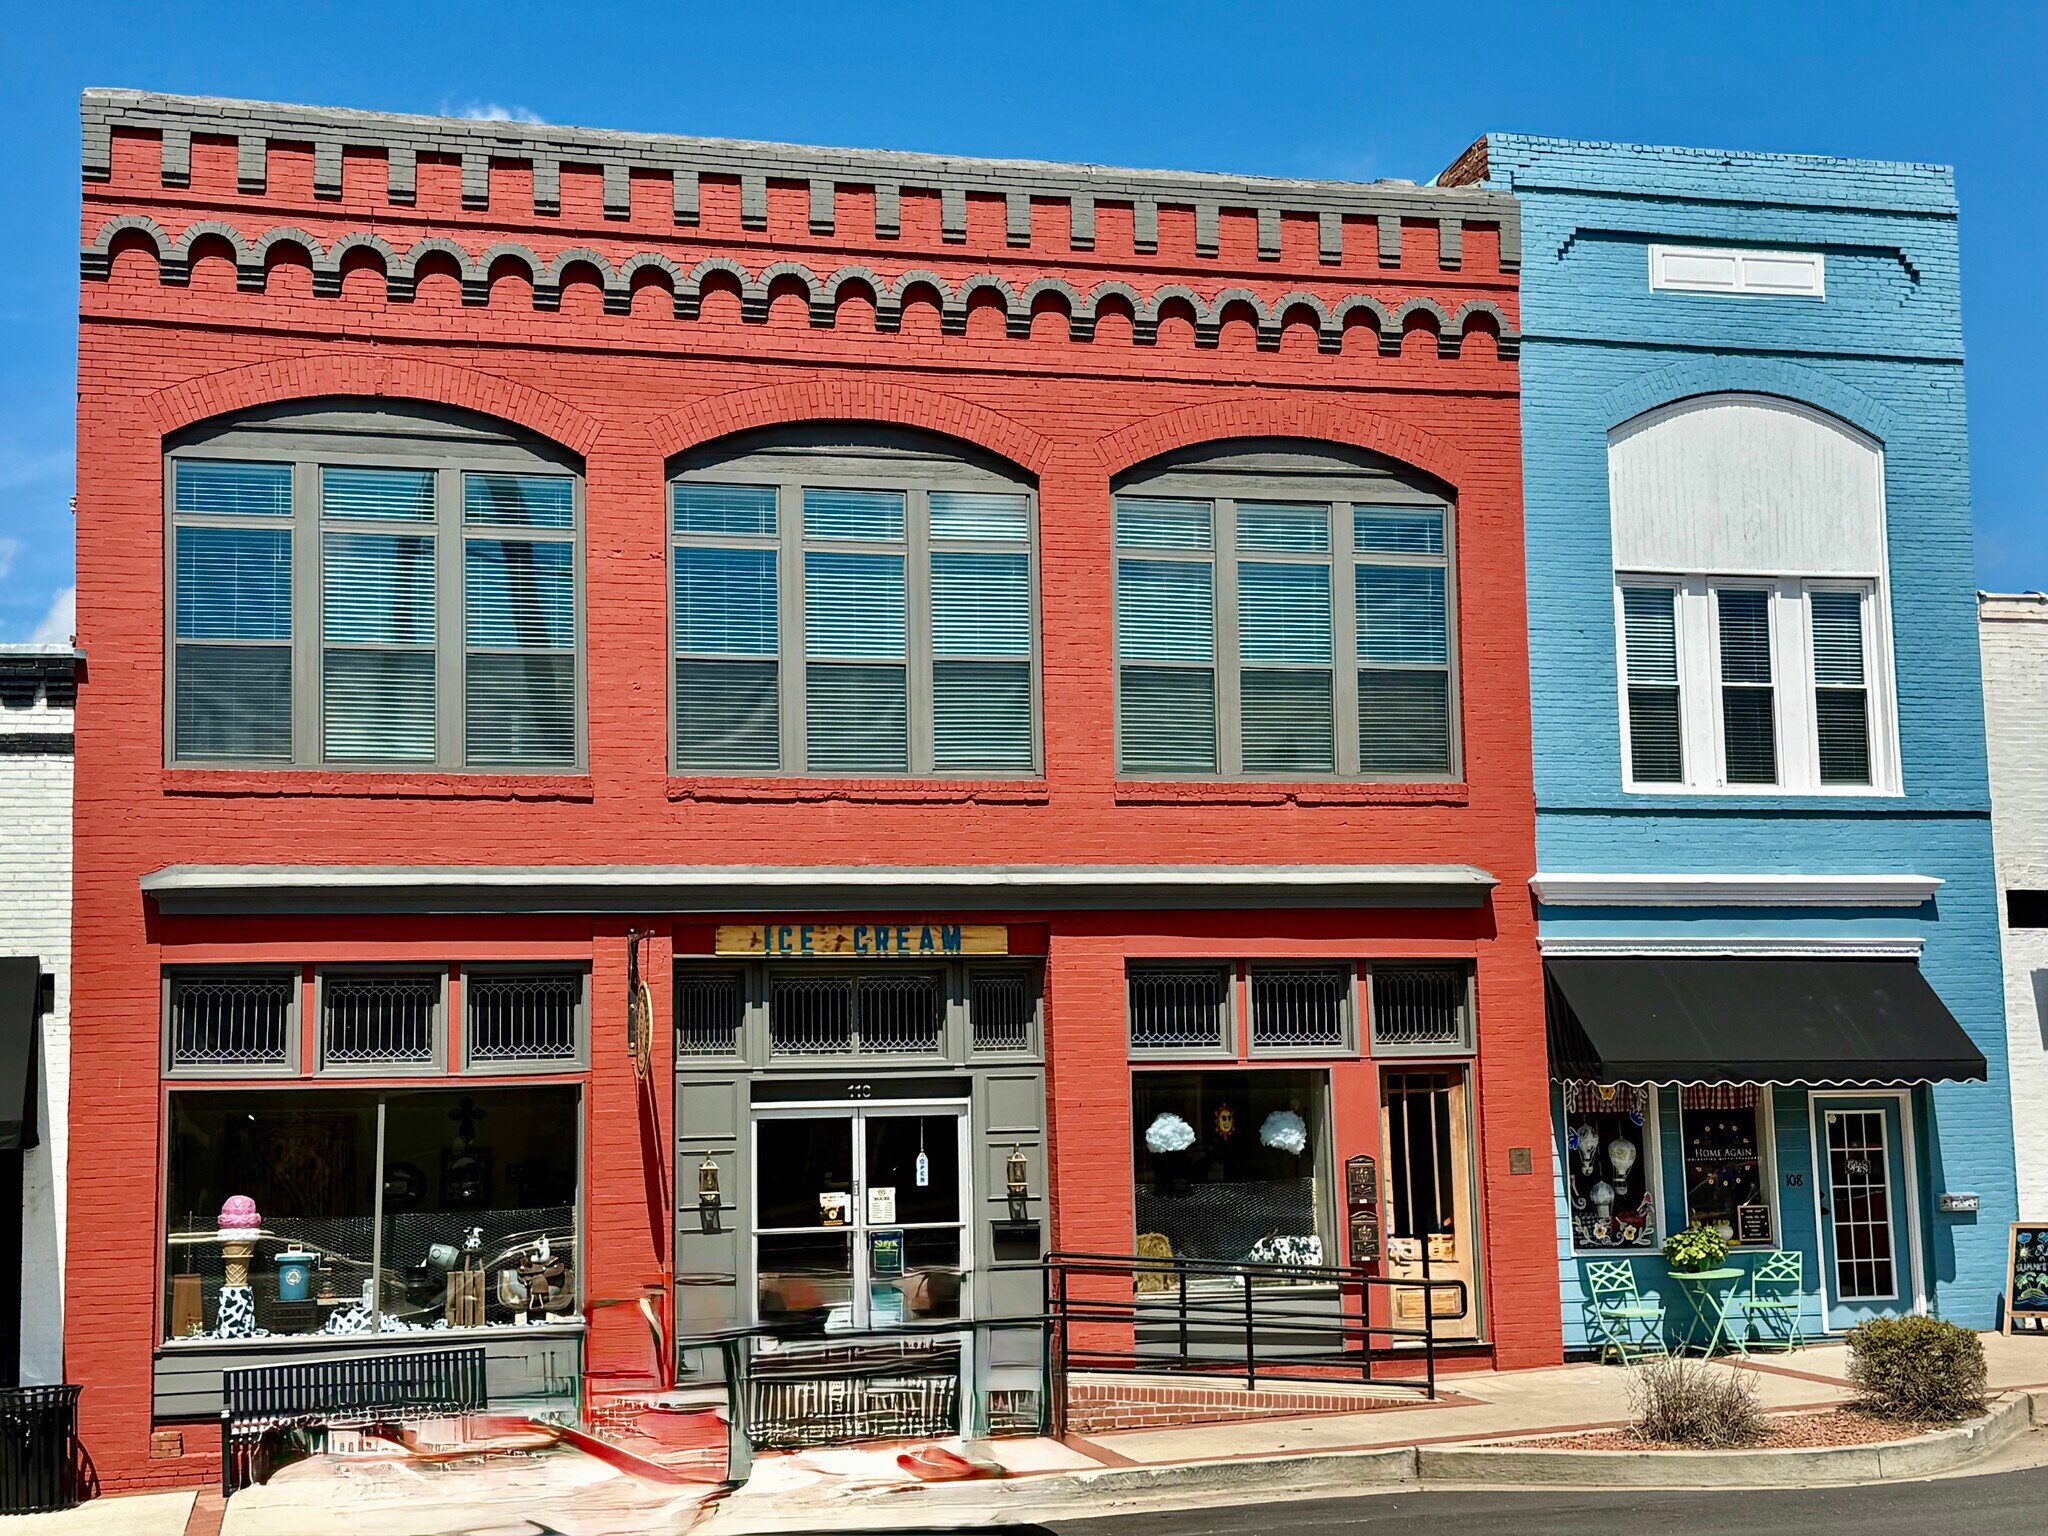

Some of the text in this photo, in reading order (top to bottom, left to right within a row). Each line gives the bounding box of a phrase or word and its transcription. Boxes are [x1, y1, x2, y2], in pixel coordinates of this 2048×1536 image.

[764, 926, 961, 956] ICE CREAM
[1695, 1148, 1752, 1158] HOME AGAIN
[1785, 1173, 1804, 1188] 108
